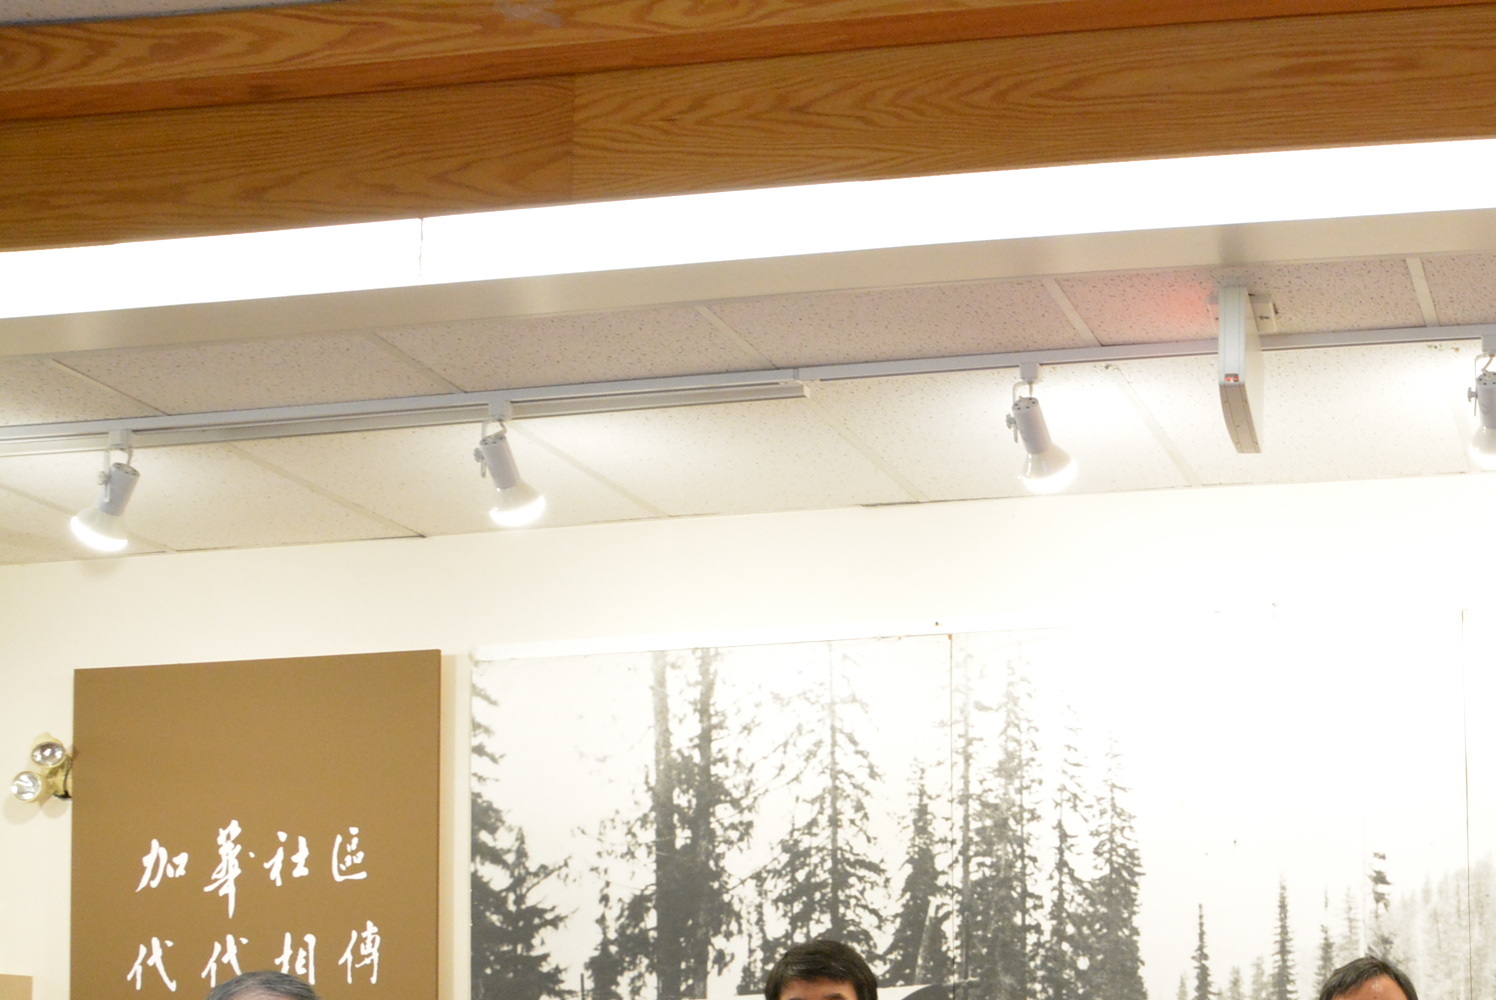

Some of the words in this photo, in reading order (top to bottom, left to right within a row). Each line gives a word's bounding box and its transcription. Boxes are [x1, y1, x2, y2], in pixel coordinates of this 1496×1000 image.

[135, 819, 367, 919] 加華社區
[126, 920, 382, 992] 代代相傳
